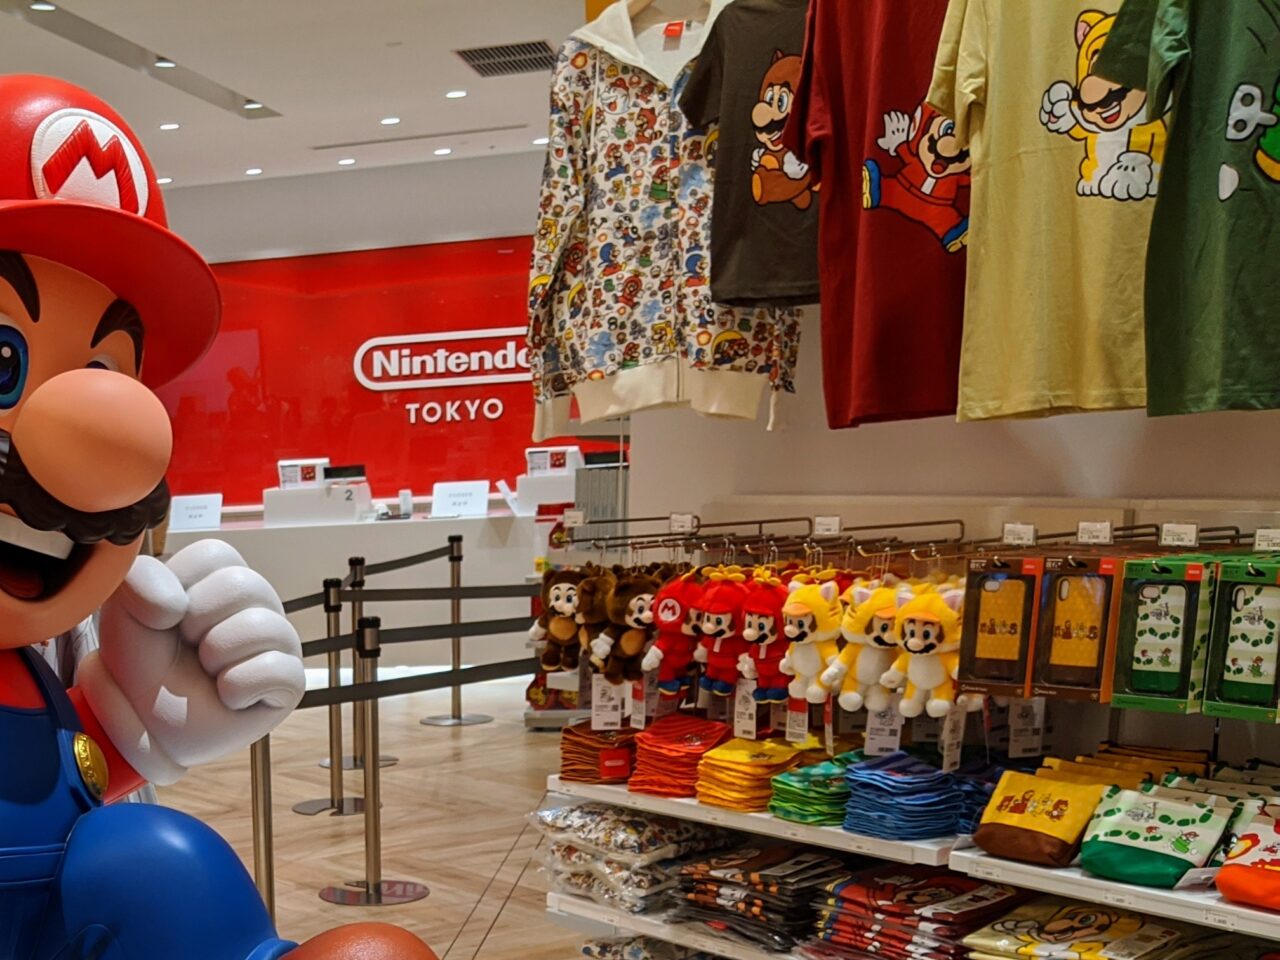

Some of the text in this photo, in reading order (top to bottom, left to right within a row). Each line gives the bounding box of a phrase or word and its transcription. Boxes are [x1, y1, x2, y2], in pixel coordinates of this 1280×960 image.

[42, 119, 140, 216] M
[405, 398, 504, 424] TOKYO
[345, 489, 353, 501] 2
[661, 603, 677, 616] M
